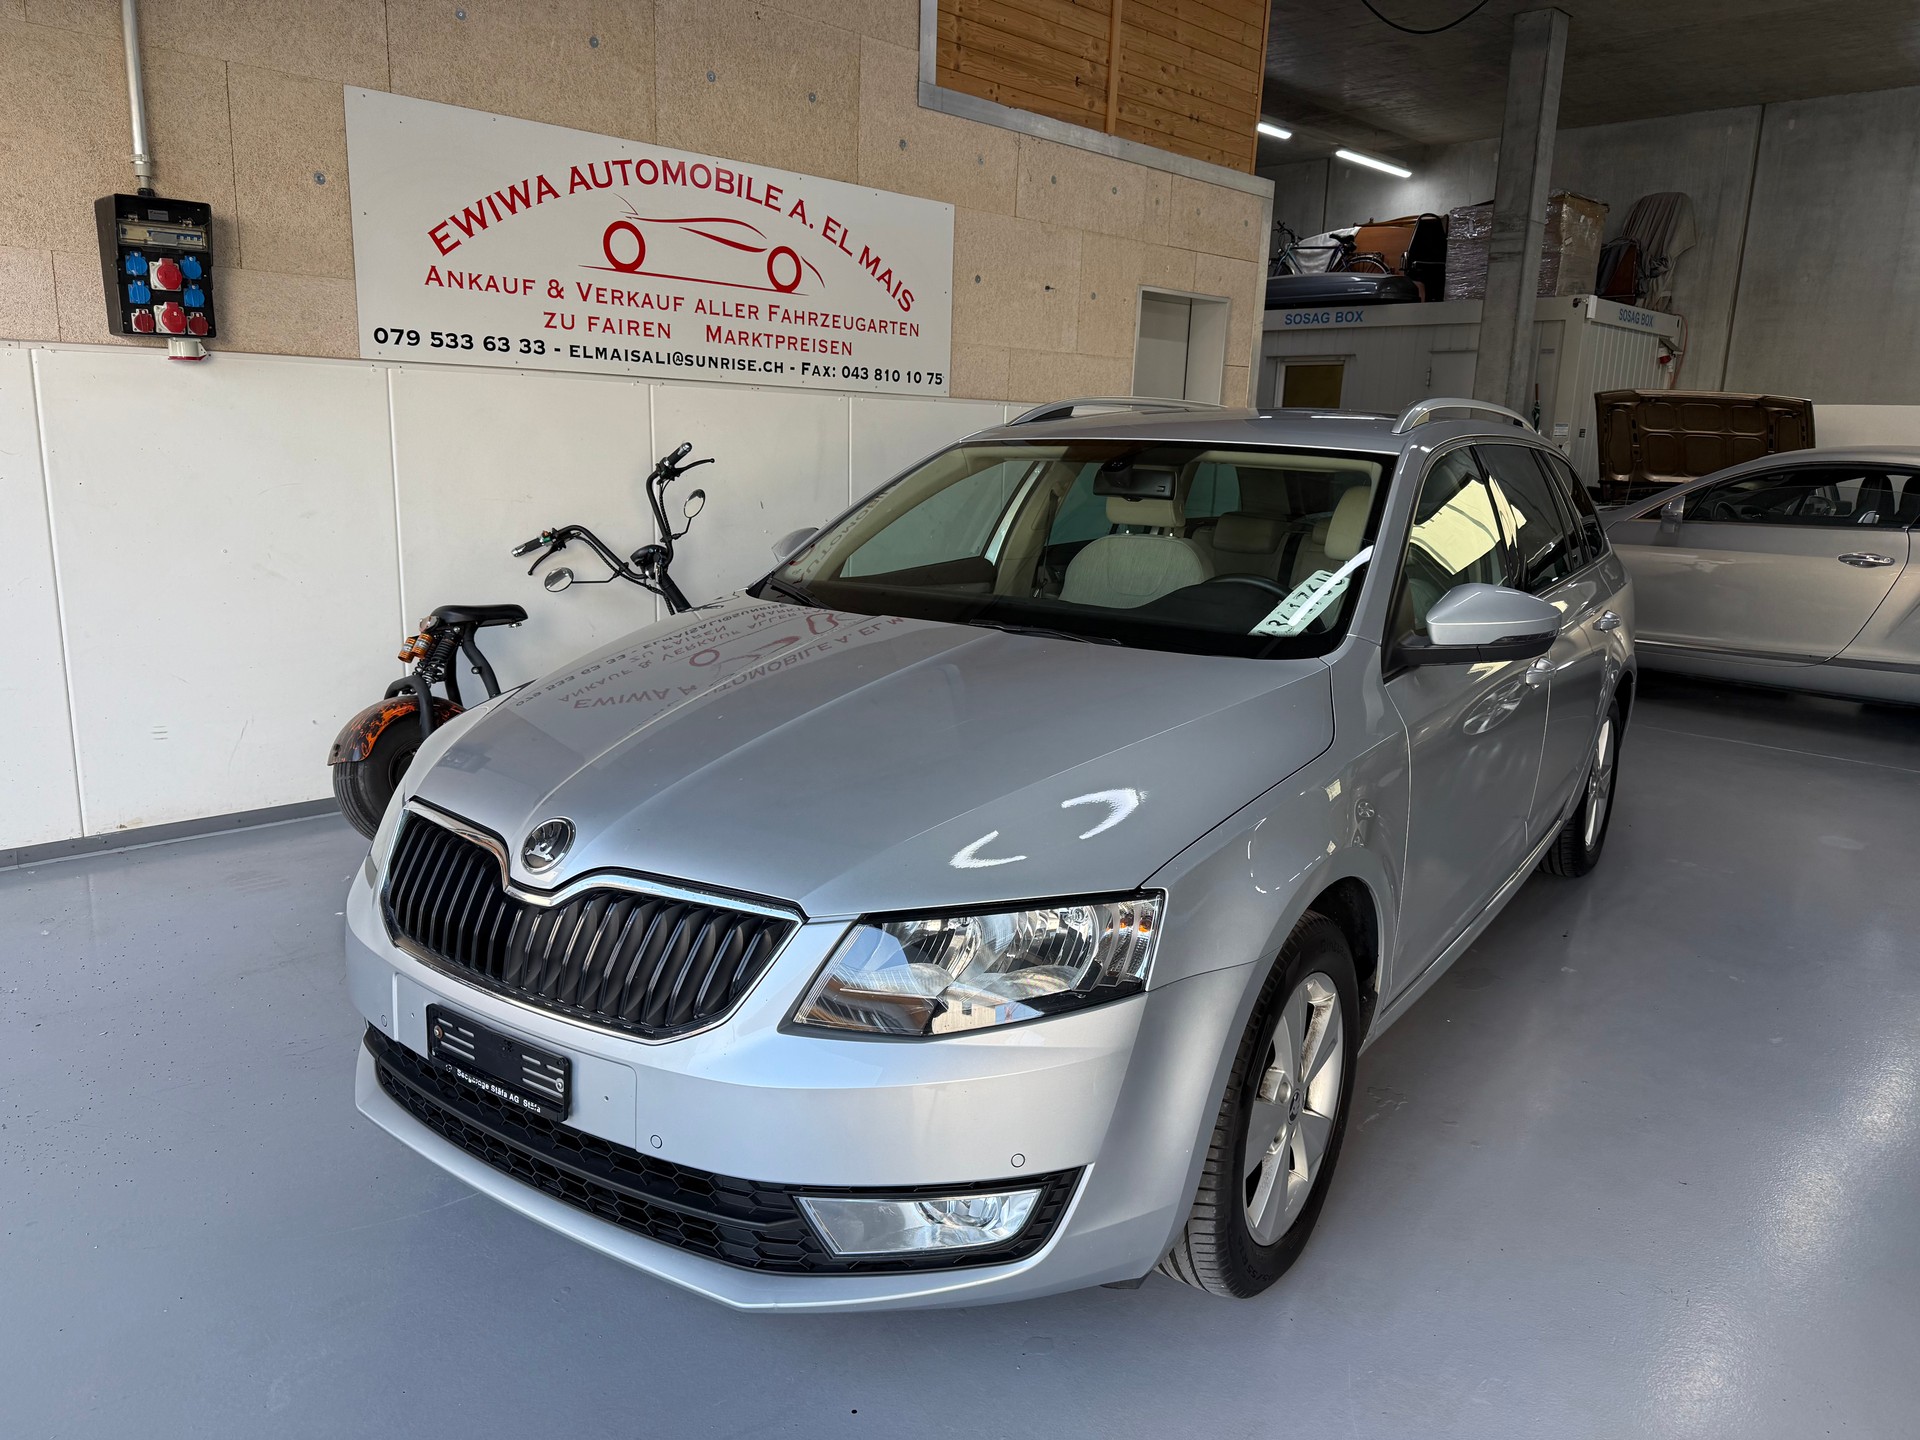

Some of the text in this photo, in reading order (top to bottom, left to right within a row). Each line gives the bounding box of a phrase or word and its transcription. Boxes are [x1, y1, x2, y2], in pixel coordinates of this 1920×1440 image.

[427, 159, 915, 312] EWIWA AUTOMOBILE A. EL MAIS
[424, 265, 920, 338] ANKAUF & VERKAUF ALLER FAHRZEUGARTEN
[1284, 310, 1364, 325] SOSAG BOX
[1618, 308, 1654, 328] SOSAG BOX
[373, 326, 421, 347] 079
[430, 331, 474, 350] 533
[483, 335, 511, 352] 63
[519, 338, 546, 355] 33
[569, 344, 784, 374] ELMAISALI@SUNRISE.CH
[801, 361, 836, 378] FAX:
[841, 365, 869, 381] 043
[874, 368, 900, 383] 810
[906, 371, 922, 384] 10
[926, 372, 943, 385] 75
[543, 311, 853, 356] ZU FAIREN MARKTPREISEN
[508, 1093, 520, 1104] AG
